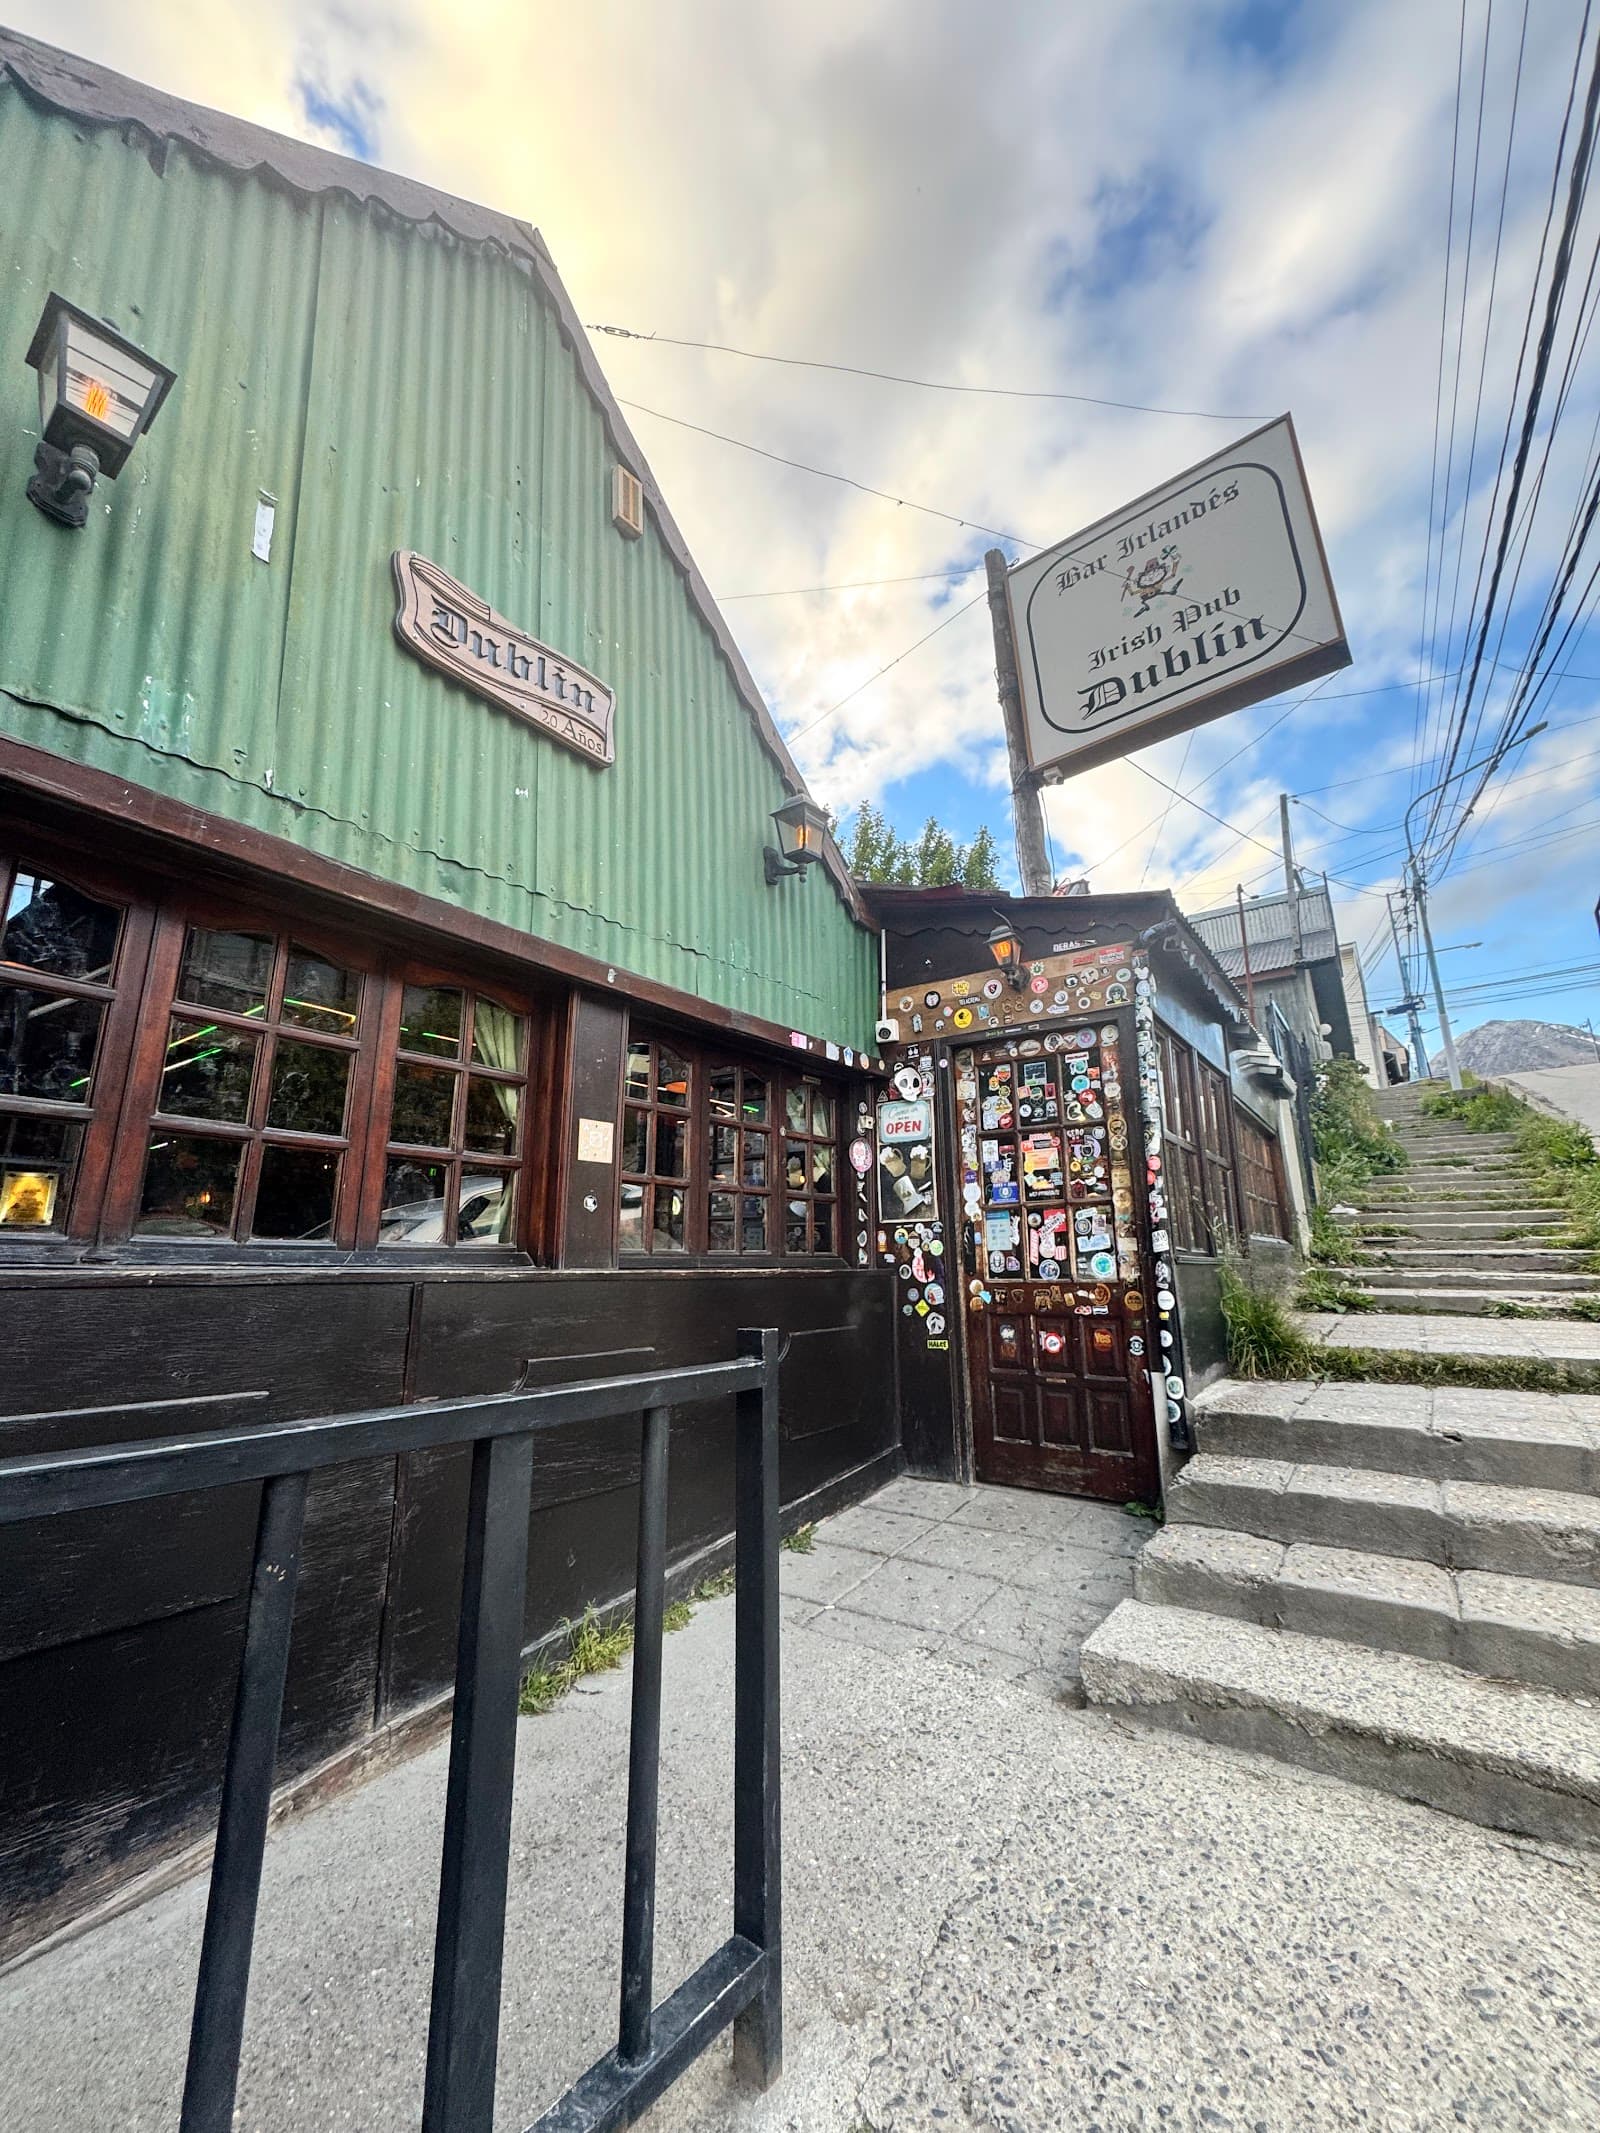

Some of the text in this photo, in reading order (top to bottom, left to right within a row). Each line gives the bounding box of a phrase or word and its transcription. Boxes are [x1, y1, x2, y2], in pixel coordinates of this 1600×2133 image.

[1055, 479, 1240, 597] Bar Irlandés
[1077, 613, 1269, 720] Dublín
[1088, 586, 1241, 673] Irish Pub
[542, 709, 603, 755] 20 Años
[886, 1120, 922, 1135] OPEN
